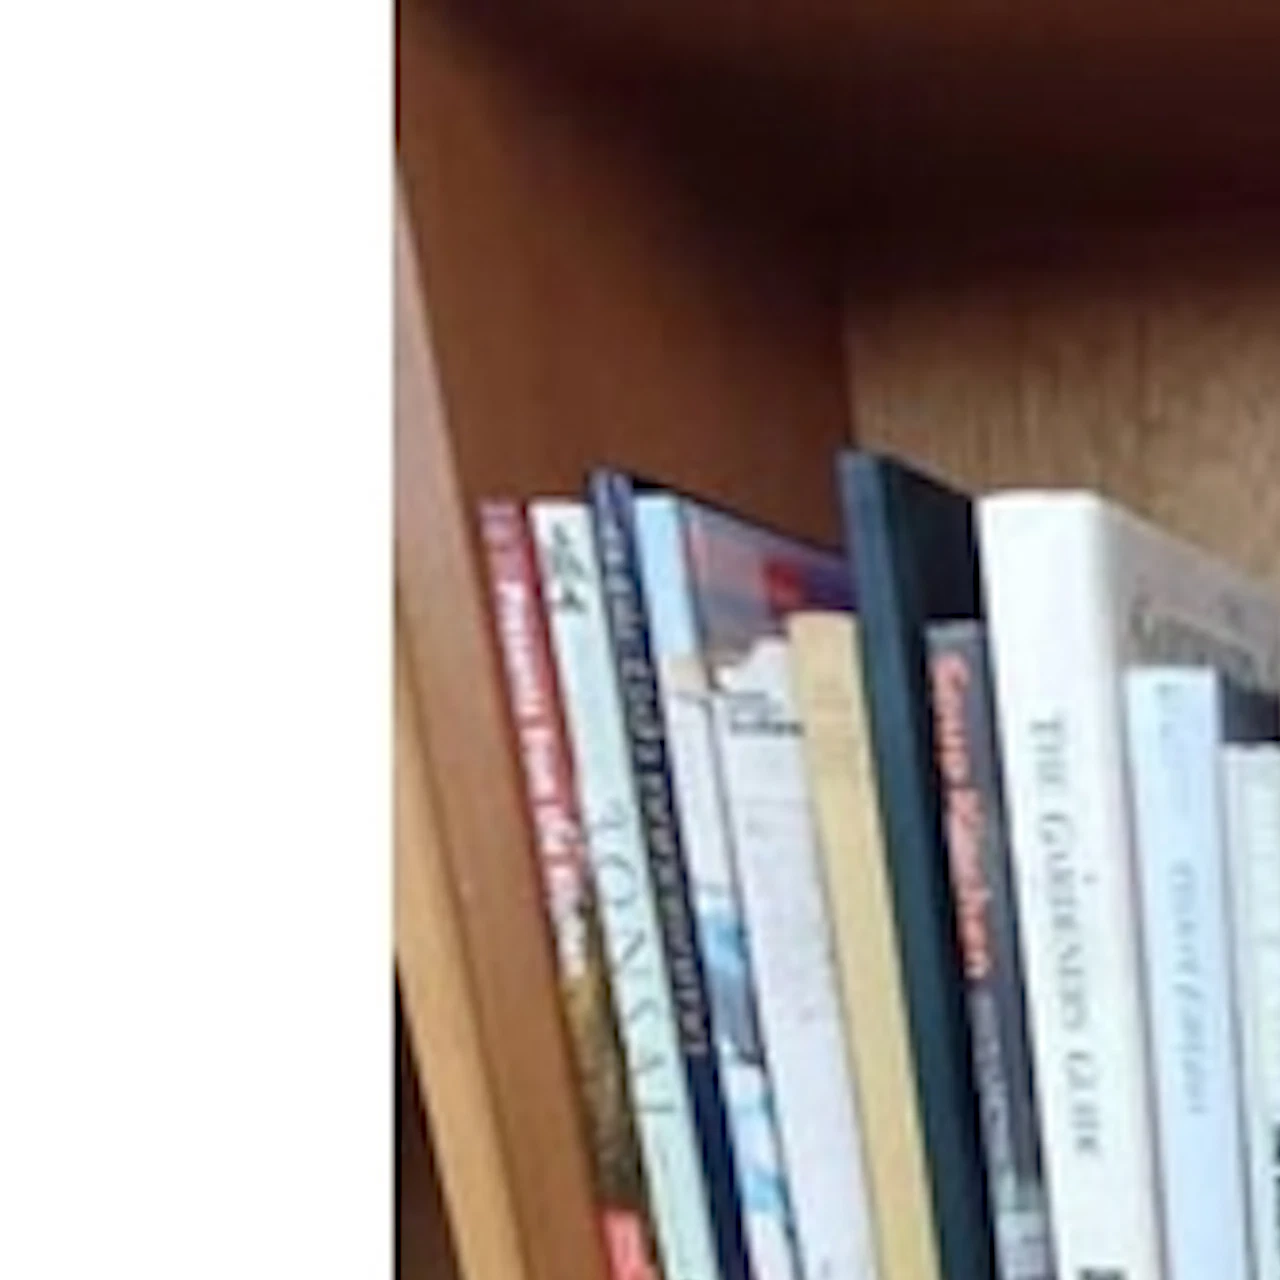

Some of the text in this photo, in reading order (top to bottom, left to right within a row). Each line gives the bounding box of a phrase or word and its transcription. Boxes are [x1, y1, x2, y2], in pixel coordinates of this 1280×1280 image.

[927, 654, 1004, 977] Soup Kitchen
[1024, 716, 1072, 791] THE
